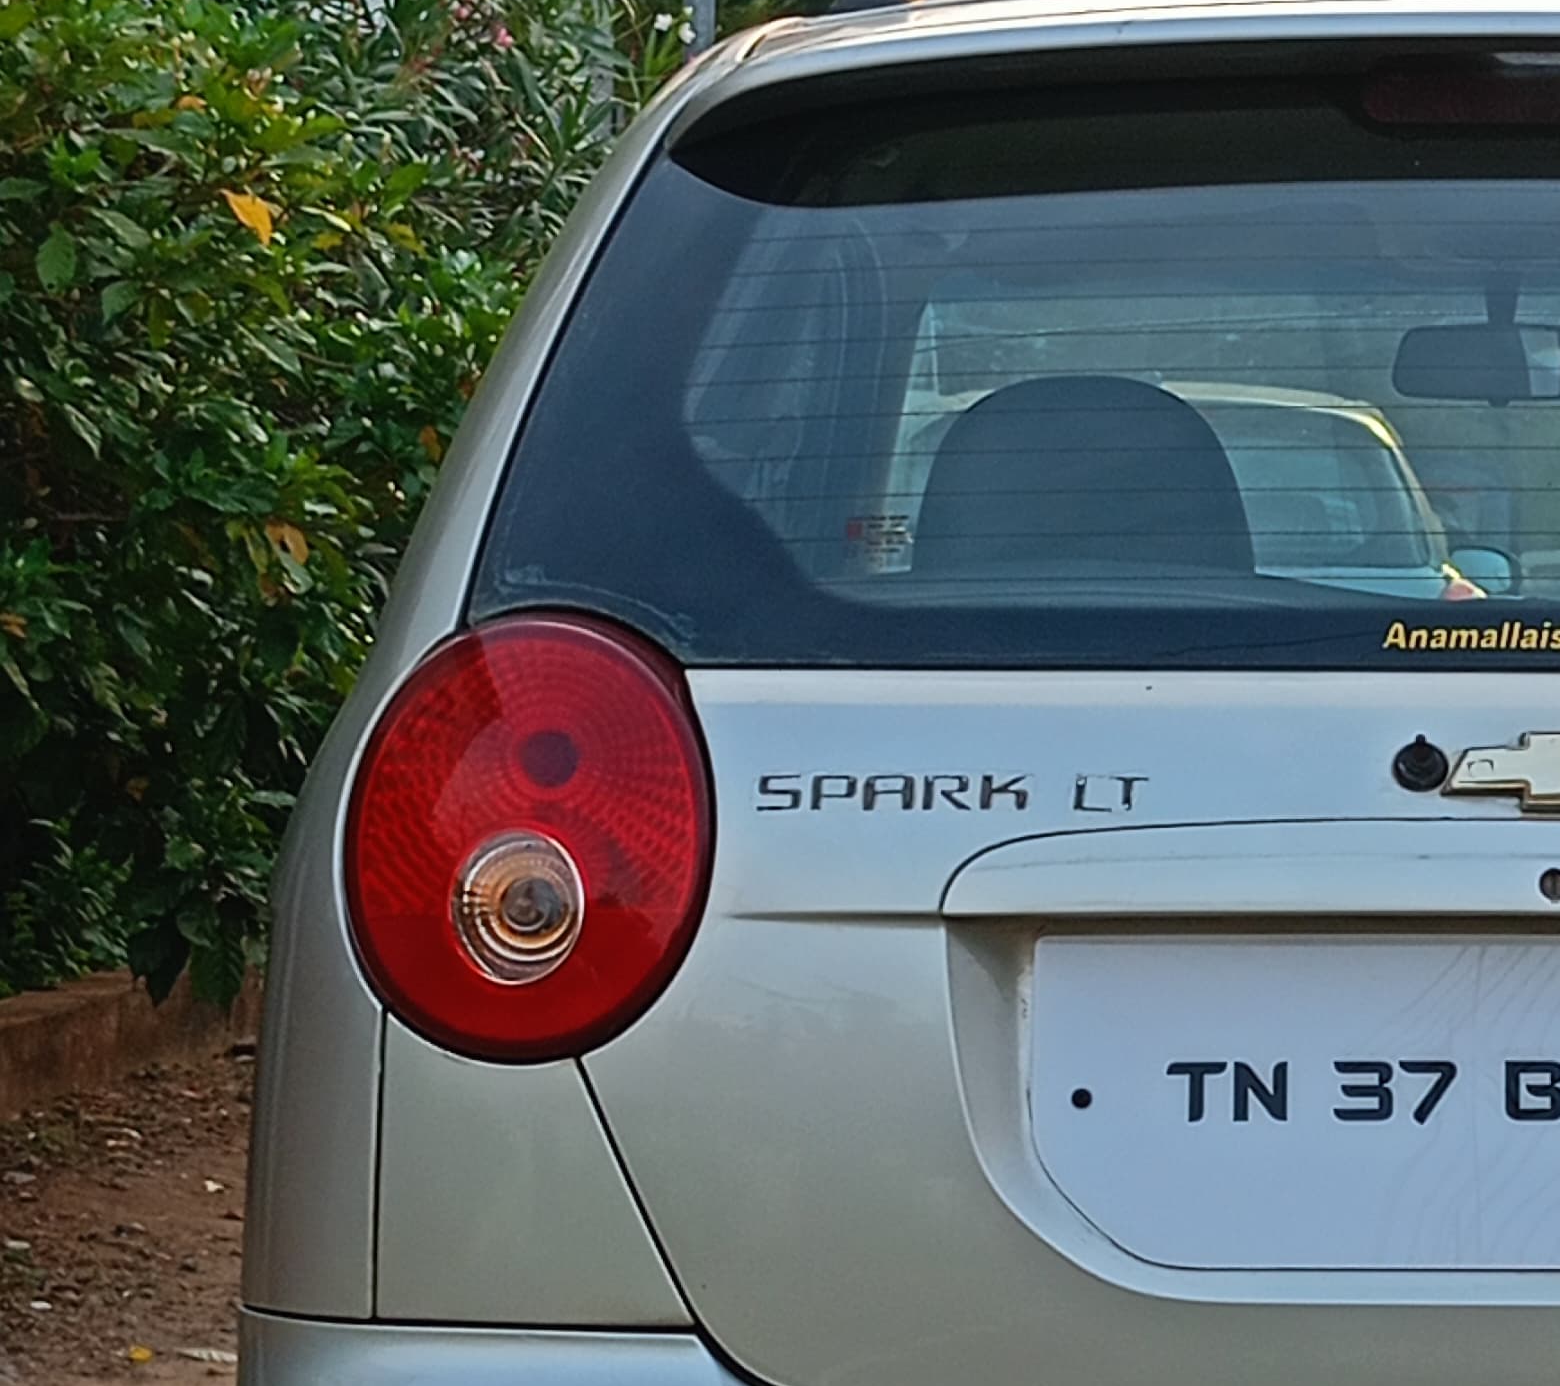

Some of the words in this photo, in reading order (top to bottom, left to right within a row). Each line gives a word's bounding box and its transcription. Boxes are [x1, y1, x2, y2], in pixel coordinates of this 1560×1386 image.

[757, 773, 1033, 812] SPARK
[1072, 773, 1150, 812] LT
[1166, 1060, 1289, 1124] TN
[1332, 1060, 1458, 1125] 37
